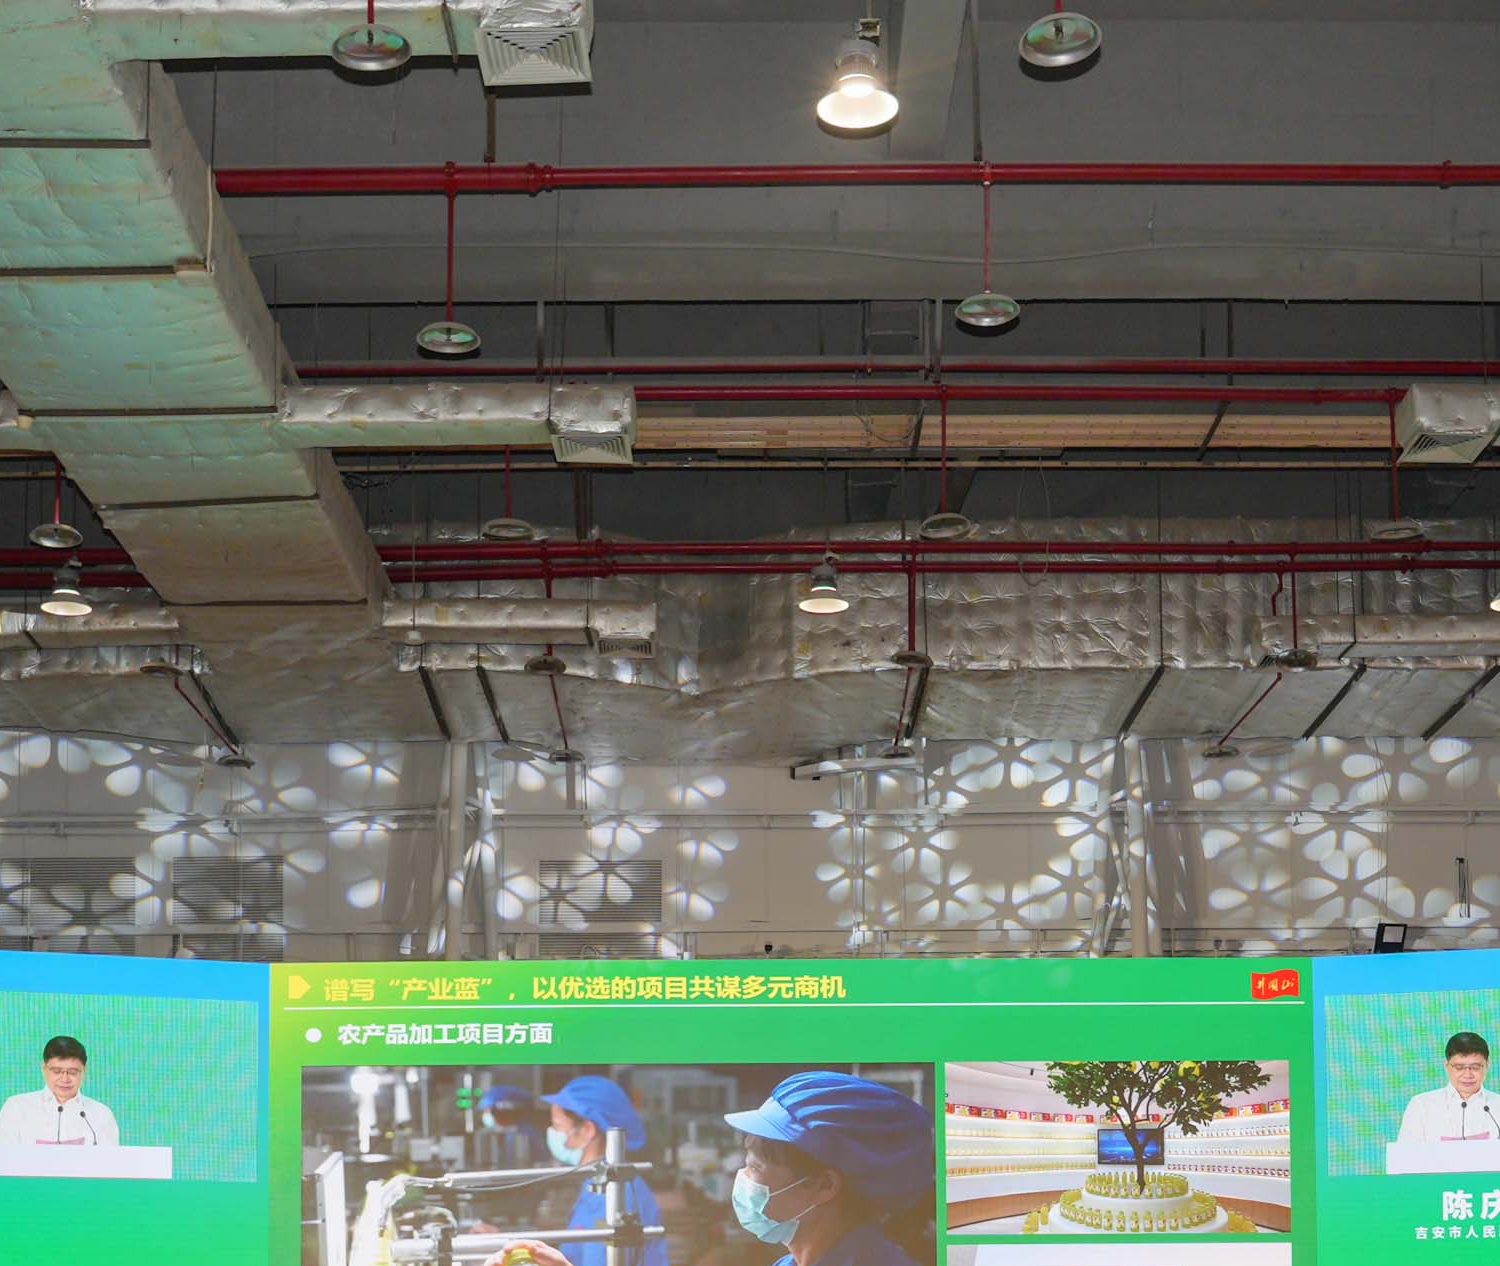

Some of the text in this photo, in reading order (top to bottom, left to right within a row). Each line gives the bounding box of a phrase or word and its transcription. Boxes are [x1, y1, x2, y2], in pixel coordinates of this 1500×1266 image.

[338, 1023, 553, 1044] 农产品加工项目方面
